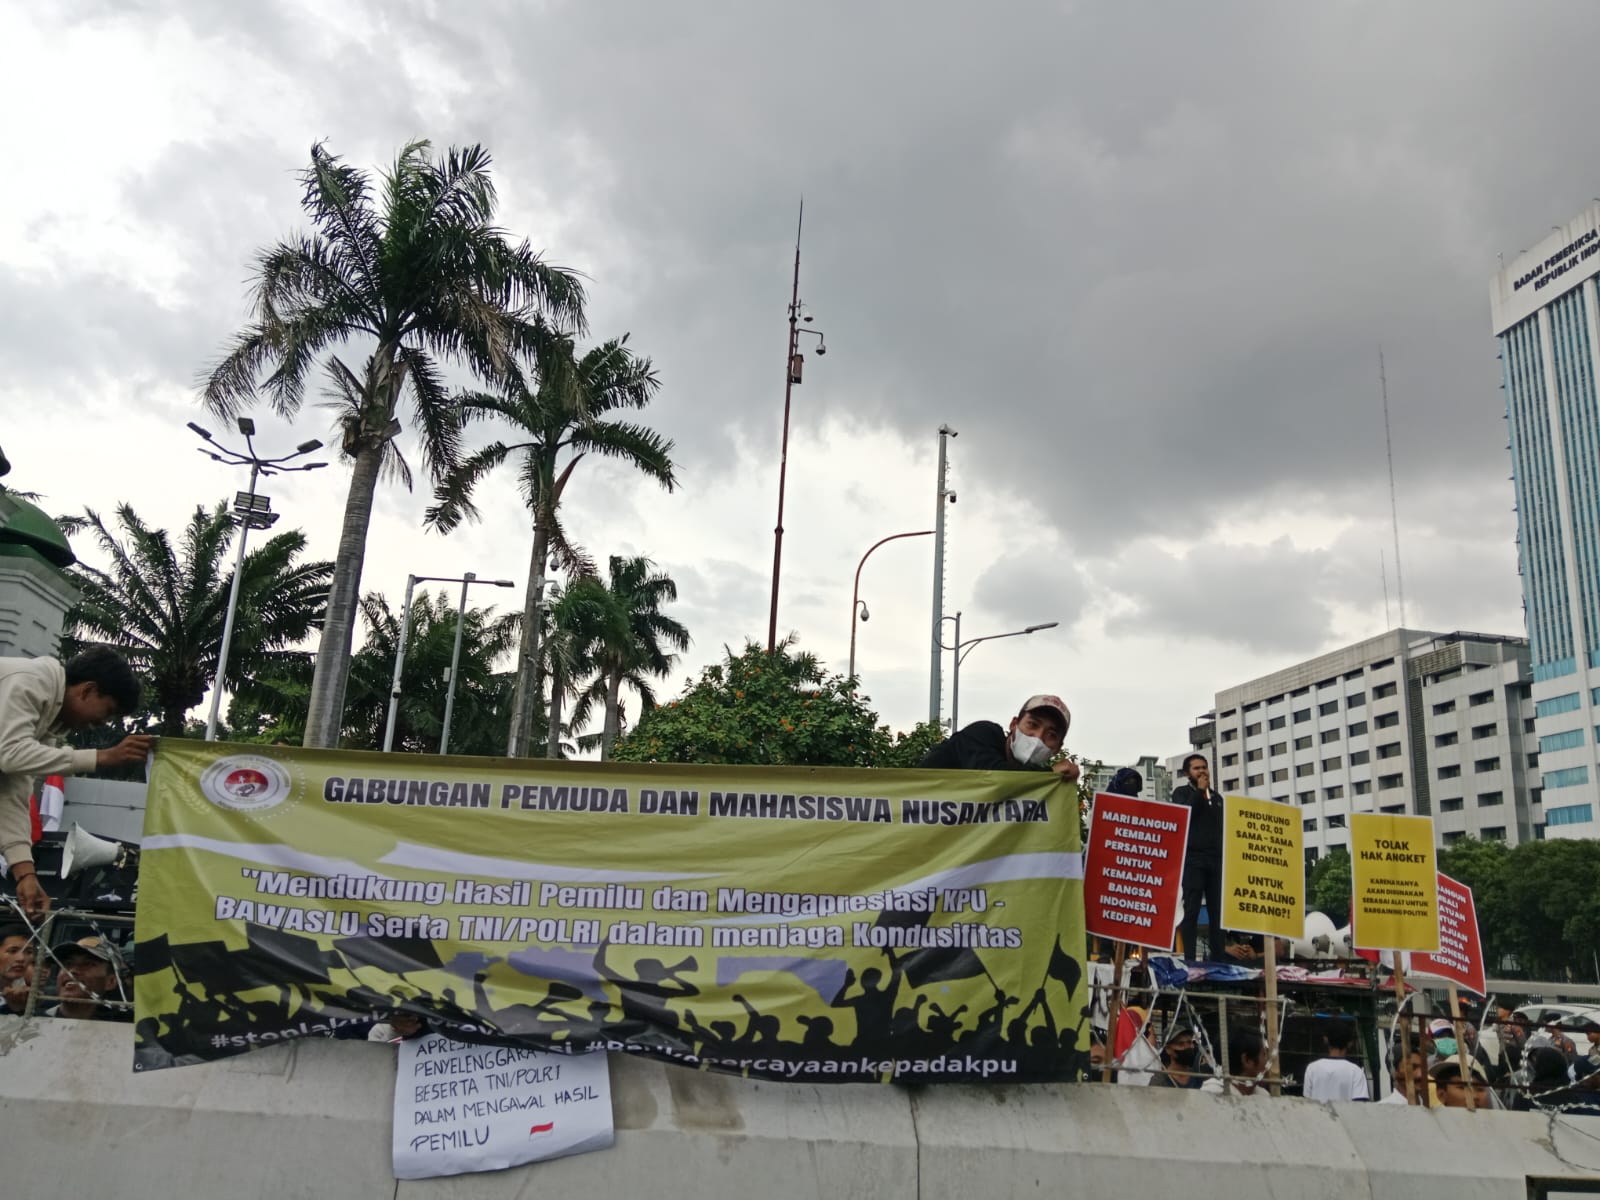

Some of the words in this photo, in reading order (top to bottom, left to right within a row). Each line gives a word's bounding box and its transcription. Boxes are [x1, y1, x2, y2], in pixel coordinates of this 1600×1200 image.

[1514, 264, 1543, 291] BADAN
[1544, 229, 1598, 270] PEMERIKSA
[1534, 254, 1579, 291] REPUBLIK
[324, 777, 490, 808] GABUNGAN
[501, 783, 629, 813] PEMUDA
[640, 789, 699, 816] DAN
[709, 792, 892, 824] MAHASISWA
[902, 799, 1049, 825] NUSANTARA
[1102, 811, 1130, 824] MARI
[1132, 816, 1178, 832] BANGUN
[1239, 810, 1290, 826] PENDUKUNG
[1115, 827, 1161, 843] KEMBALI
[1247, 822, 1259, 831] 01,
[1260, 825, 1273, 834] 02,
[1274, 827, 1283, 835] 03
[1236, 831, 1262, 841] SAMA
[1270, 836, 1293, 847] SAMA
[1374, 840, 1409, 850] TOLAK
[1105, 840, 1168, 859] PERSATUAN
[1248, 843, 1283, 856] RAKYAT
[1361, 851, 1383, 861] HAK
[1386, 853, 1426, 863] ANGKET
[1116, 856, 1152, 870] UNTUK
[1242, 853, 1288, 867] INDONESIA
[1103, 868, 1163, 886] KEMAJUAN
[1248, 875, 1284, 889] UNTUK
[242, 868, 446, 906] "Mendukung
[454, 880, 530, 908] Hasil
[540, 882, 644, 911] Pemilu
[652, 886, 708, 912] dan
[717, 887, 939, 917] Mengapresiasi
[943, 888, 986, 913] KPU
[1108, 883, 1152, 899] BANGSA
[1234, 888, 1257, 900] APA
[1260, 891, 1296, 906] SALING
[1437, 886, 1467, 904] ANGUN
[1100, 895, 1158, 914] INDONESIA
[1238, 903, 1291, 919] SERANG?!
[215, 895, 360, 938] BAWASLU
[368, 913, 449, 940] Serta
[459, 915, 601, 944] TNI/POLRI
[608, 920, 704, 947] dalam
[712, 923, 844, 949] menjaga
[852, 922, 1023, 949] Kondusifitas
[1103, 910, 1152, 927] KEDEPAN
[1440, 906, 1466, 922] ATUAN
[1440, 927, 1468, 943] AJUAN
[1430, 953, 1469, 974] KEDEPAN
[415, 1048, 537, 1077] PENYELENGGARA
[415, 1079, 479, 1103] BESERTA
[486, 1065, 561, 1089] TNI/POLRI
[414, 1107, 456, 1125] DALAM
[464, 1095, 545, 1117] MENGAWAL
[554, 1086, 599, 1105] HASIL
[410, 1125, 490, 1153] PEMILU
